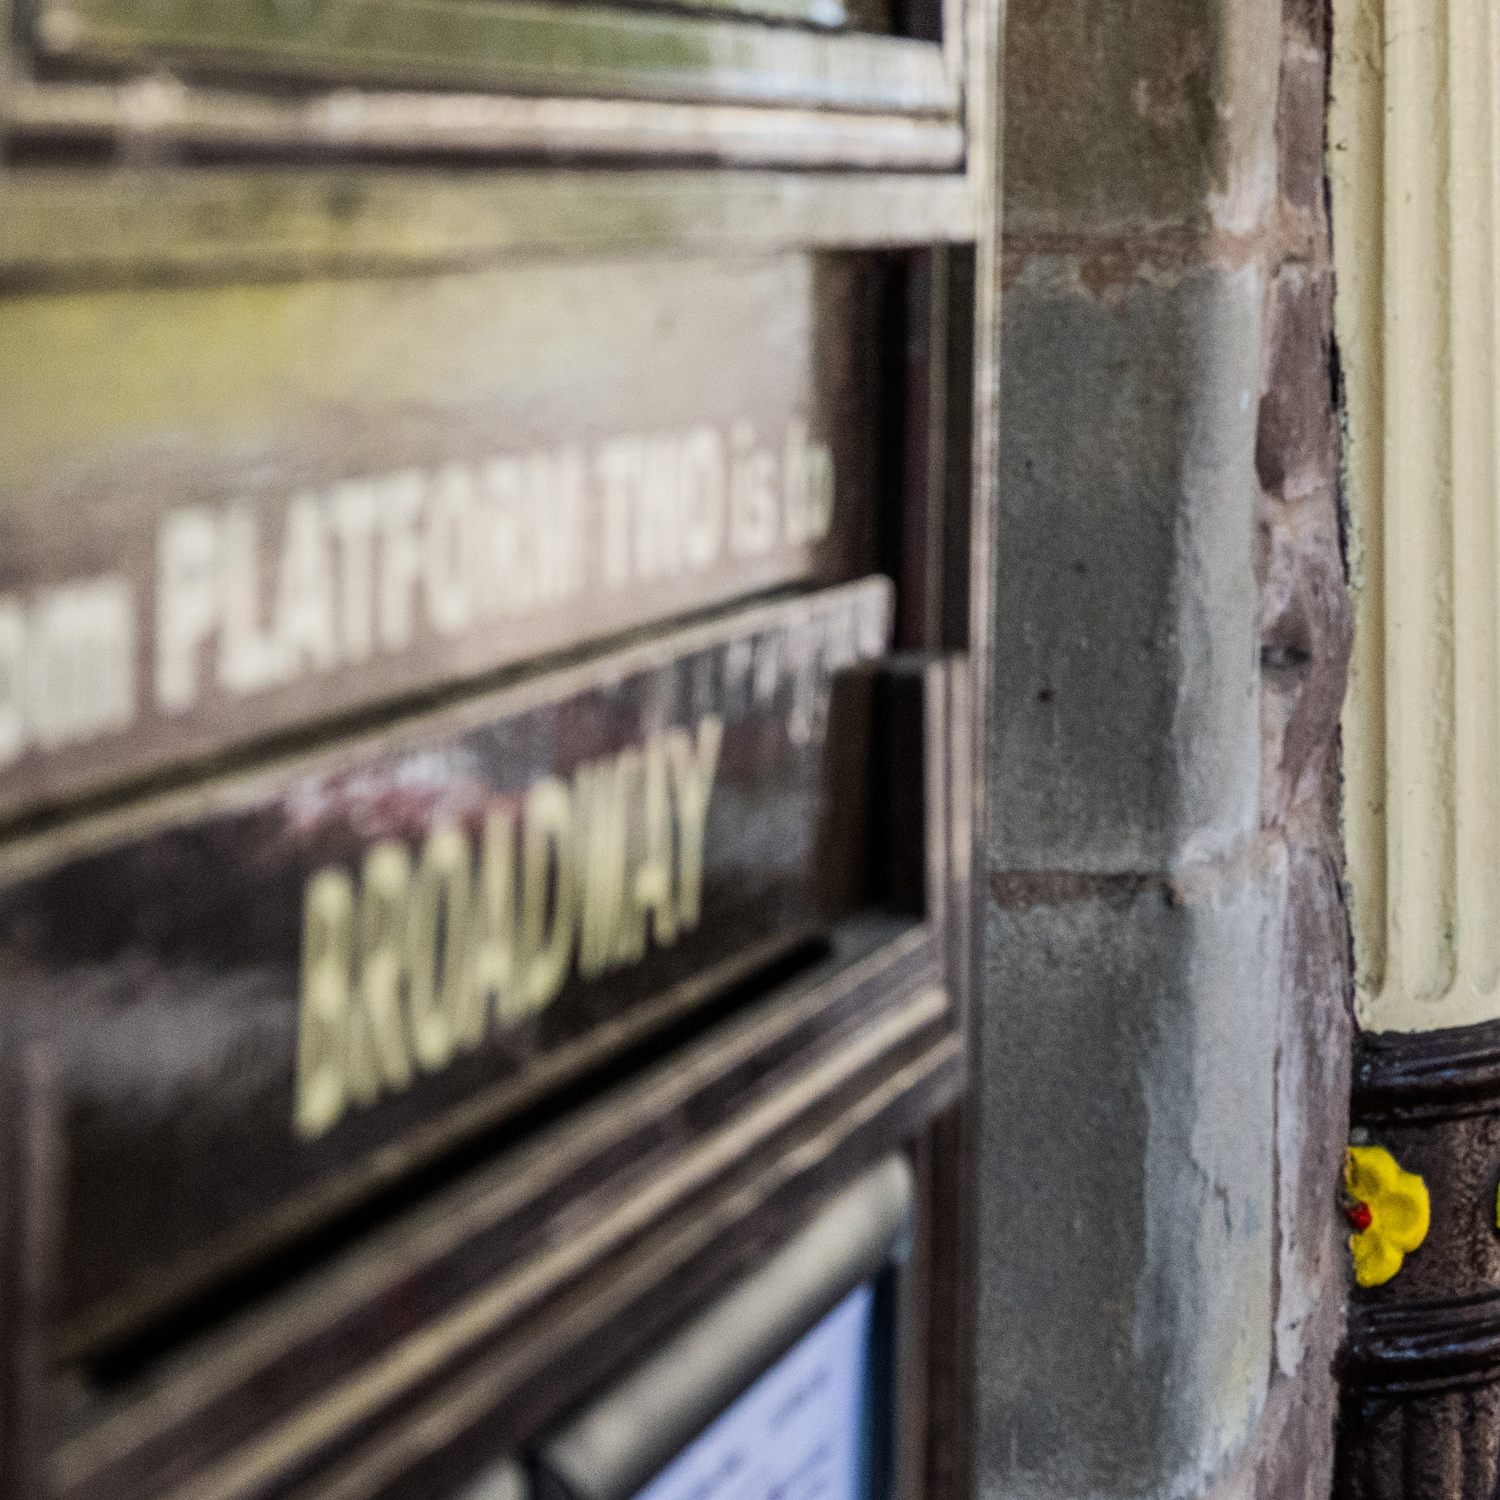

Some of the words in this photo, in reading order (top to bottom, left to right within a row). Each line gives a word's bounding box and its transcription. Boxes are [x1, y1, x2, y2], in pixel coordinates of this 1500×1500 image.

[153, 448, 588, 714] PLATFORM
[597, 422, 724, 588] TWO
[730, 417, 780, 558] is
[293, 714, 723, 1142] BROADWAY
